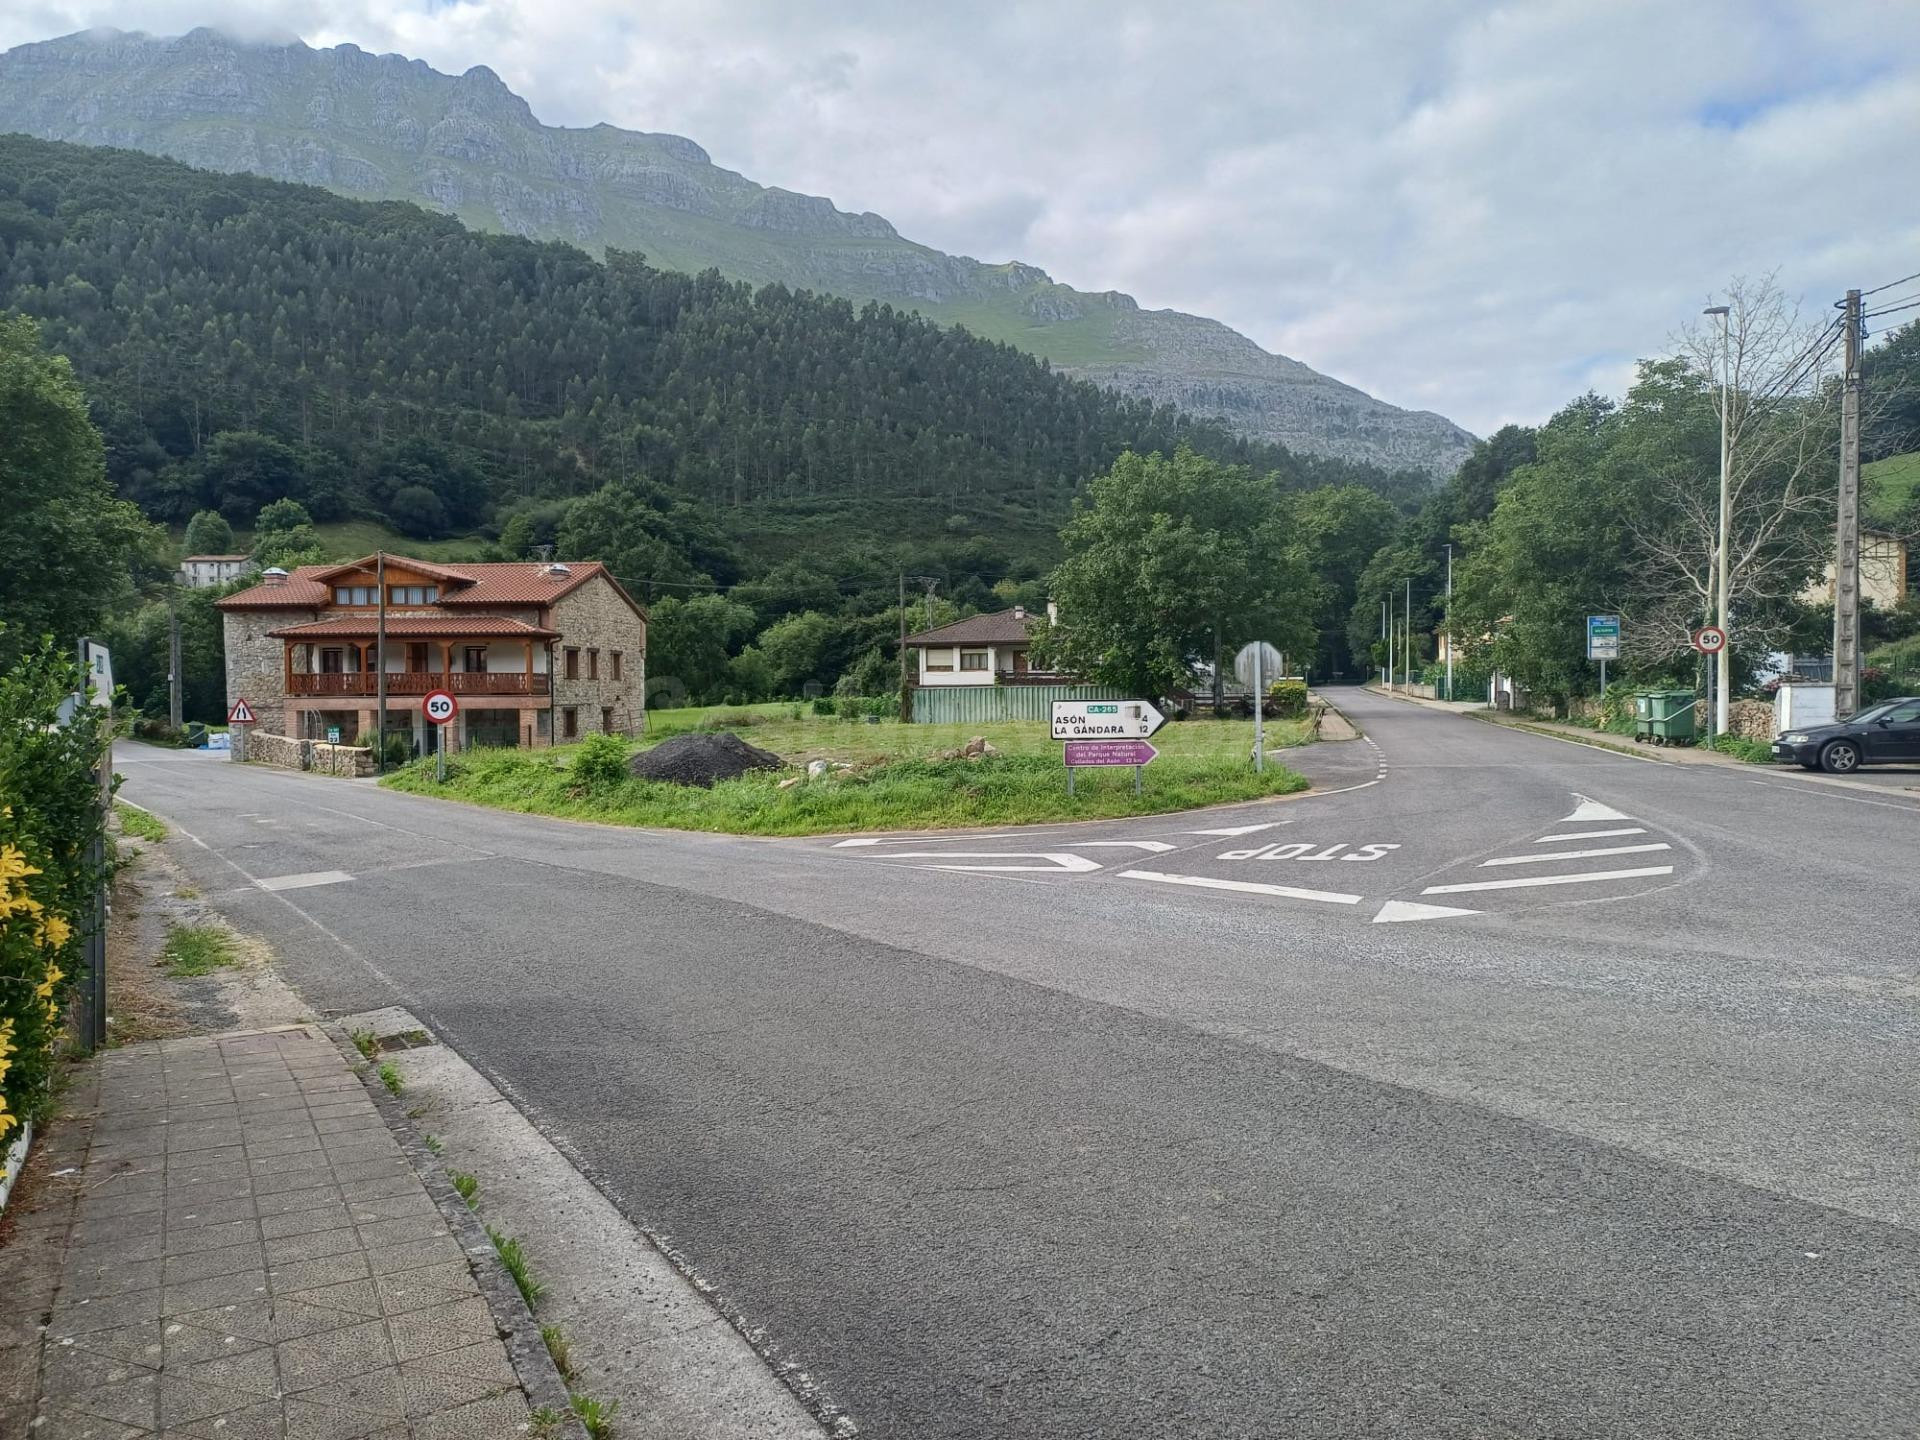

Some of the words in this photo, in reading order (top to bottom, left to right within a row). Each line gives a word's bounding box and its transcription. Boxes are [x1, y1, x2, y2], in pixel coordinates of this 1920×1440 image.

[1703, 635, 1720, 644] 50
[430, 701, 450, 713] 50
[1055, 715, 1086, 724] ASÓN
[1142, 715, 1148, 723] 4
[1054, 727, 1067, 735] LA
[1073, 725, 1125, 735] GÁNDARA
[1216, 843, 1402, 861] STOP
